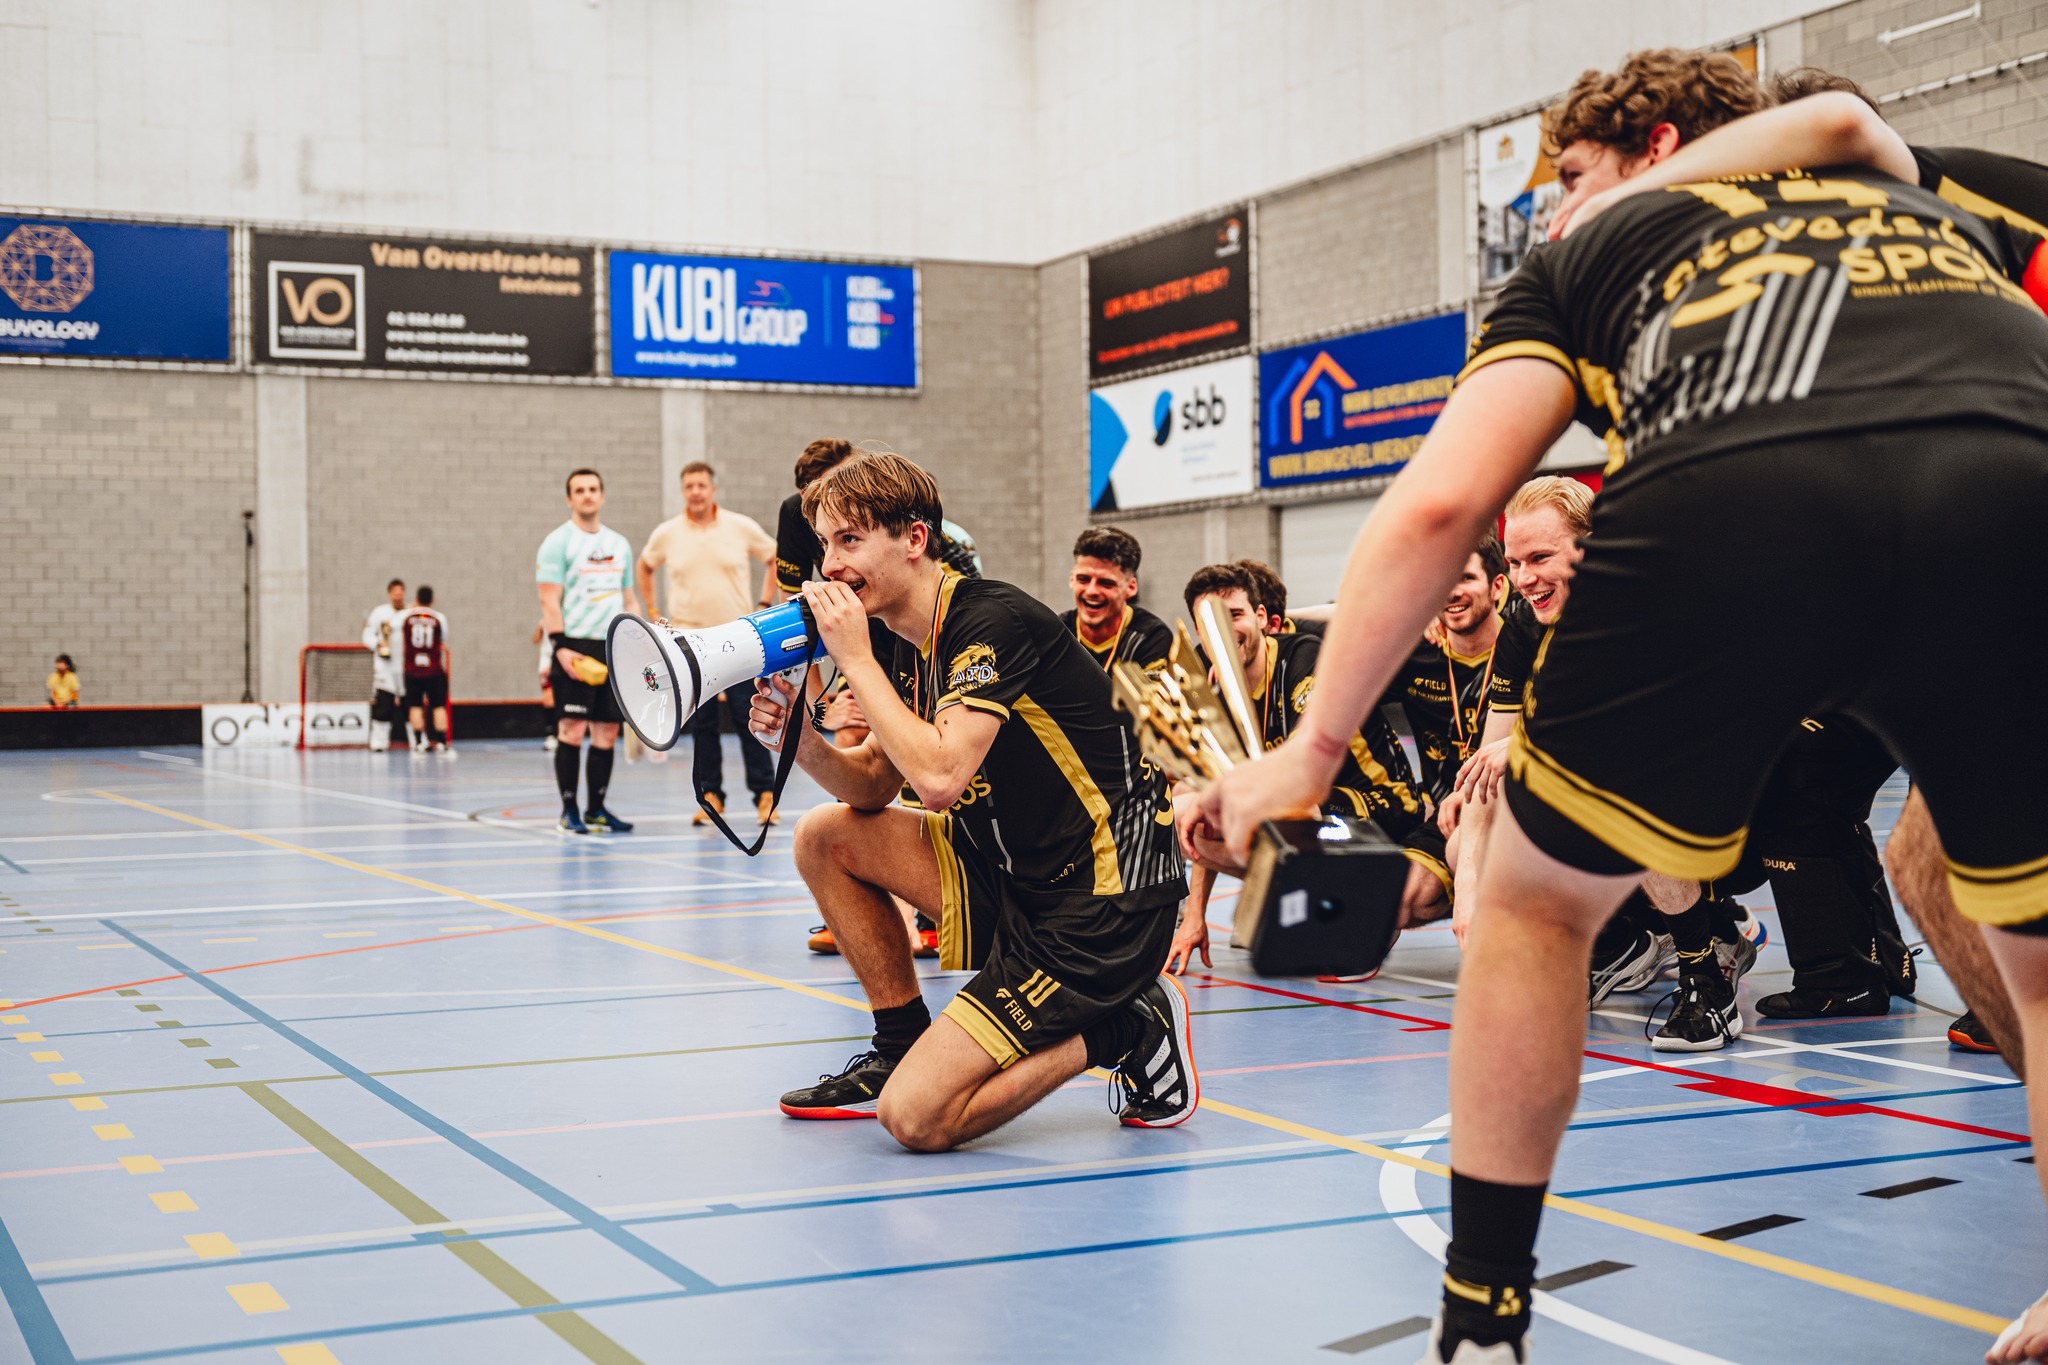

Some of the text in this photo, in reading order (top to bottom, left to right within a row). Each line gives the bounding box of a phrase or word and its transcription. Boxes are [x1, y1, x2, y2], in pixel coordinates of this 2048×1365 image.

[371, 242, 420, 269] Van
[281, 277, 353, 326] VO
[1182, 383, 1226, 431] sbb
